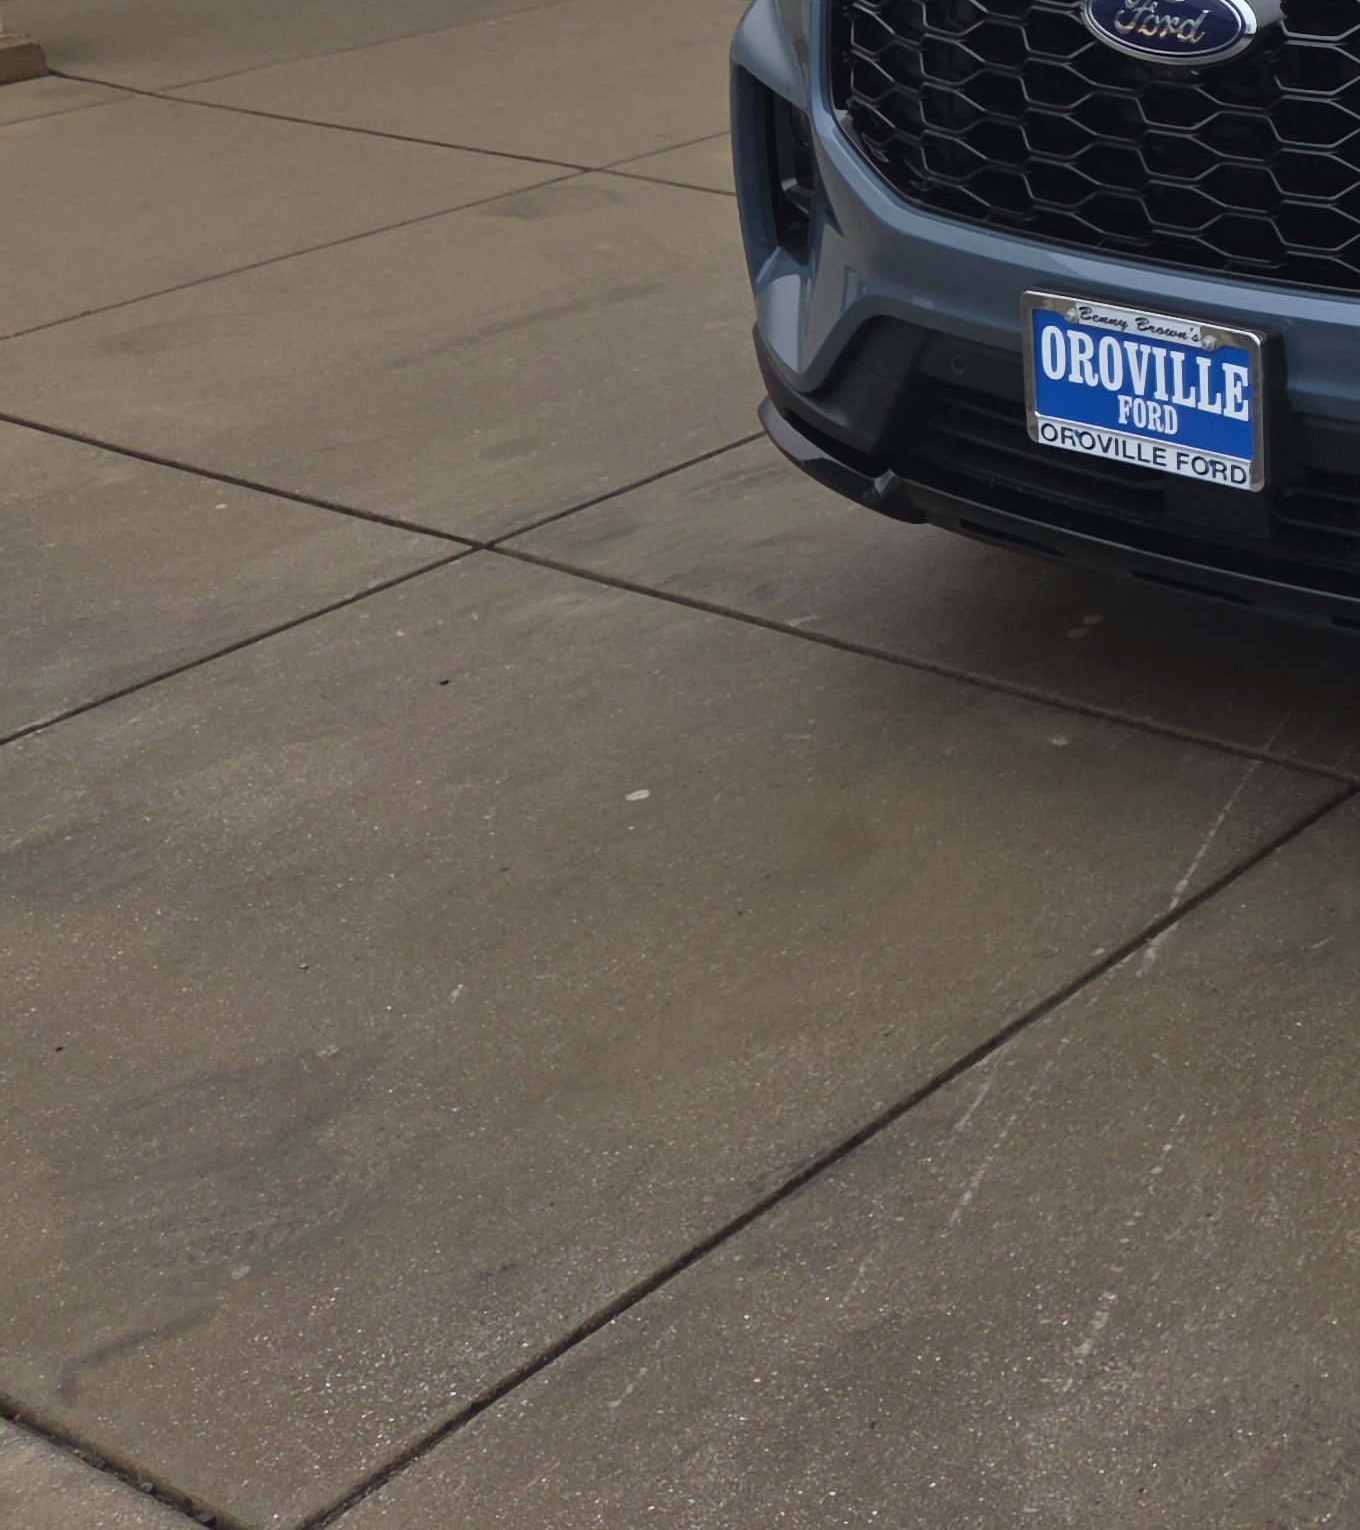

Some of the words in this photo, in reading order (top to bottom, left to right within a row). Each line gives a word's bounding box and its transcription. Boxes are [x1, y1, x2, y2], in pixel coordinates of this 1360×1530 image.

[1078, 305, 1129, 332] Benny
[1134, 316, 1201, 343] Brown's
[1040, 324, 1250, 422] OROVILLE
[1116, 394, 1179, 436] FORD
[1039, 422, 1168, 468] OROVILLE
[1175, 450, 1248, 486] FORD
